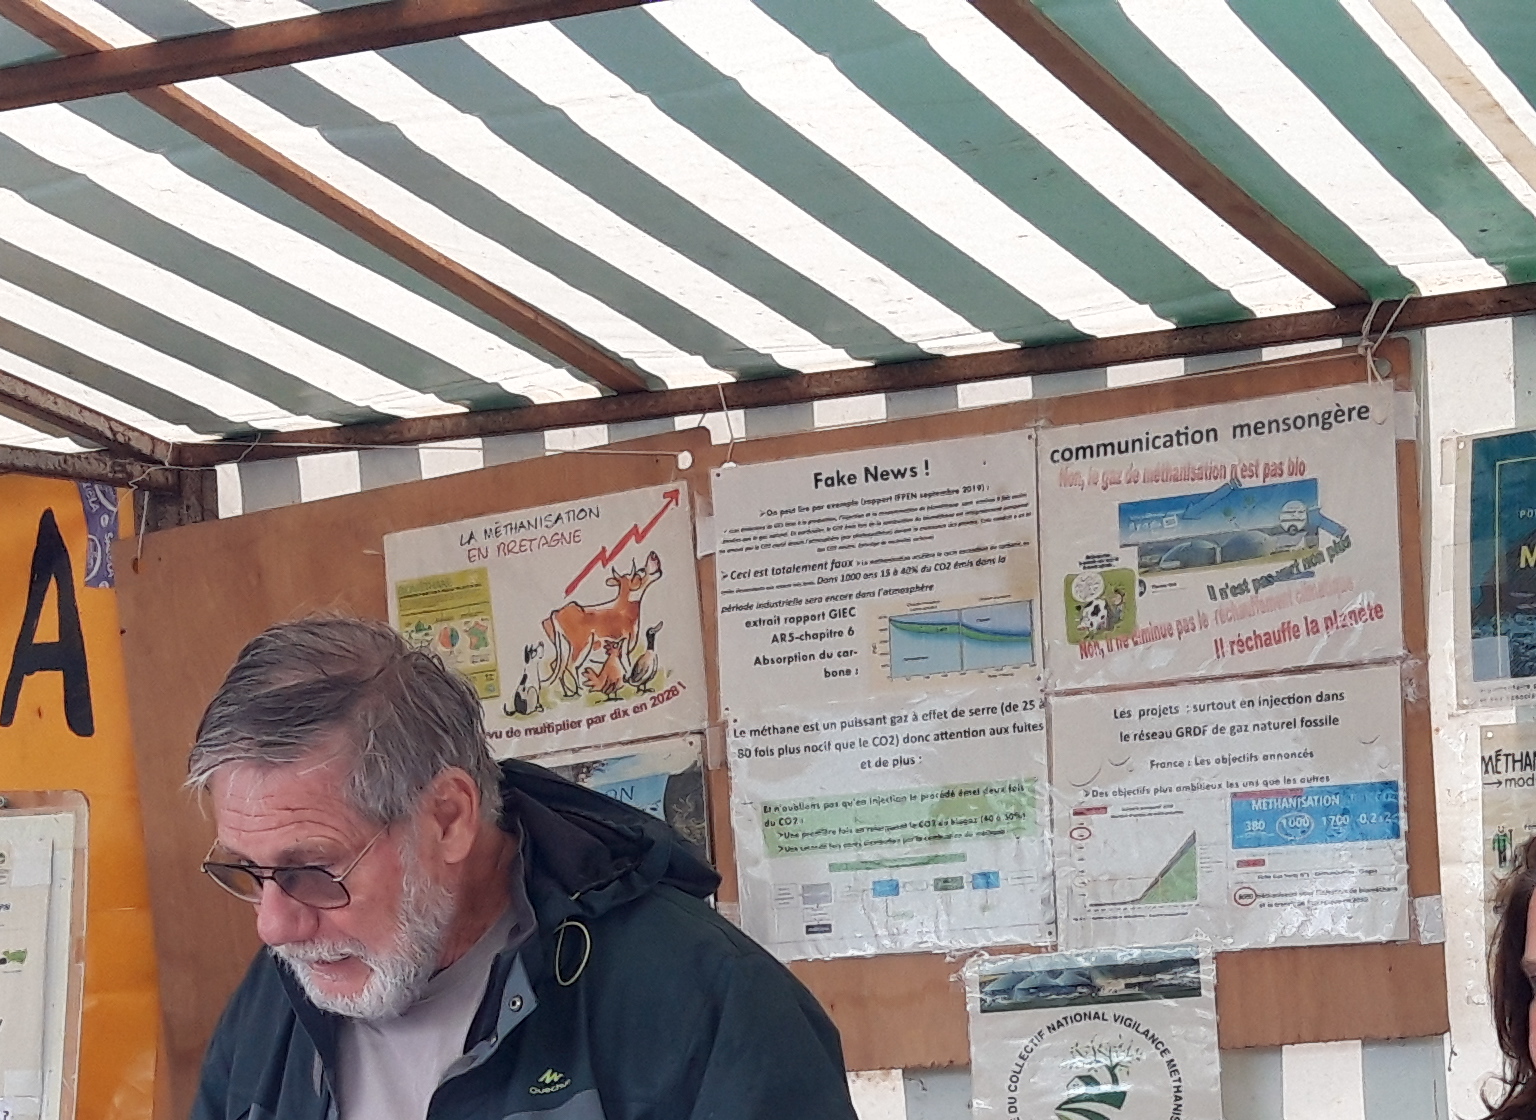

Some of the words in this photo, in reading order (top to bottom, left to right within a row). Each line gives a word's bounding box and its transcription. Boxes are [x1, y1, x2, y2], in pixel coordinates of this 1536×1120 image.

[1049, 425, 1218, 464] communication
[1232, 403, 1370, 441] mensongère
[814, 468, 858, 490] Fake
[864, 464, 918, 484] News
[459, 529, 476, 547] LA
[467, 548, 489, 563] EN
[754, 565, 768, 577] est
[771, 561, 828, 577] totalement
[830, 557, 853, 573] faux
[745, 614, 781, 628] extrait
[784, 611, 825, 627] rapport
[828, 606, 856, 620] GIEC
[847, 626, 855, 637] 6
[1229, 620, 1301, 656] réchauffe
[1305, 615, 1321, 637] la
[754, 651, 816, 666] Absorption
[818, 648, 834, 660] du
[836, 648, 858, 659] car-
[824, 666, 852, 678] bone
[524, 719, 582, 738] multiplier
[586, 714, 607, 729] par
[610, 706, 630, 721] dix
[632, 703, 647, 714] en
[649, 688, 679, 709] 2028
[1114, 708, 1132, 720] Les
[1138, 704, 1180, 722] projets
[1239, 699, 1255, 709] en
[1257, 691, 1312, 710] injection
[1315, 690, 1345, 703] dans
[733, 728, 747, 738] Le
[750, 722, 800, 738] méthane
[803, 722, 820, 732] est
[823, 720, 837, 731] un
[840, 714, 887, 732] puissant
[890, 712, 909, 726] gaz
[921, 707, 948, 721] effet
[951, 706, 966, 718] de
[968, 704, 998, 717] serre
[1000, 701, 1019, 716] (de
[1022, 700, 1036, 711] 25
[1119, 731, 1131, 743] le
[1133, 728, 1173, 741] réseau
[1175, 725, 1209, 738] GRDF
[1211, 724, 1226, 736] de
[1229, 724, 1250, 736] gaz
[1252, 718, 1297, 732] naturel
[1299, 715, 1340, 728] fossile
[754, 746, 775, 758] fois
[777, 742, 801, 758] plus
[804, 739, 832, 754] nocif
[834, 740, 856, 753] que
[858, 738, 869, 748] le
[871, 734, 900, 749] CO2)
[903, 732, 931, 745] donc
[933, 727, 986, 742] attention
[989, 726, 1010, 735] aux
[1012, 721, 1044, 734] fuites
[860, 759, 872, 770] et
[875, 756, 890, 768] de
[892, 754, 915, 769] plus
[1194, 756, 1212, 766] Les
[1046, 1010, 1109, 1034] NATIONAL
[1112, 1014, 1172, 1059] VIGILANCE
[1008, 1031, 1046, 1093] COLLECTIF
[1008, 1097, 1018, 1114] DU
